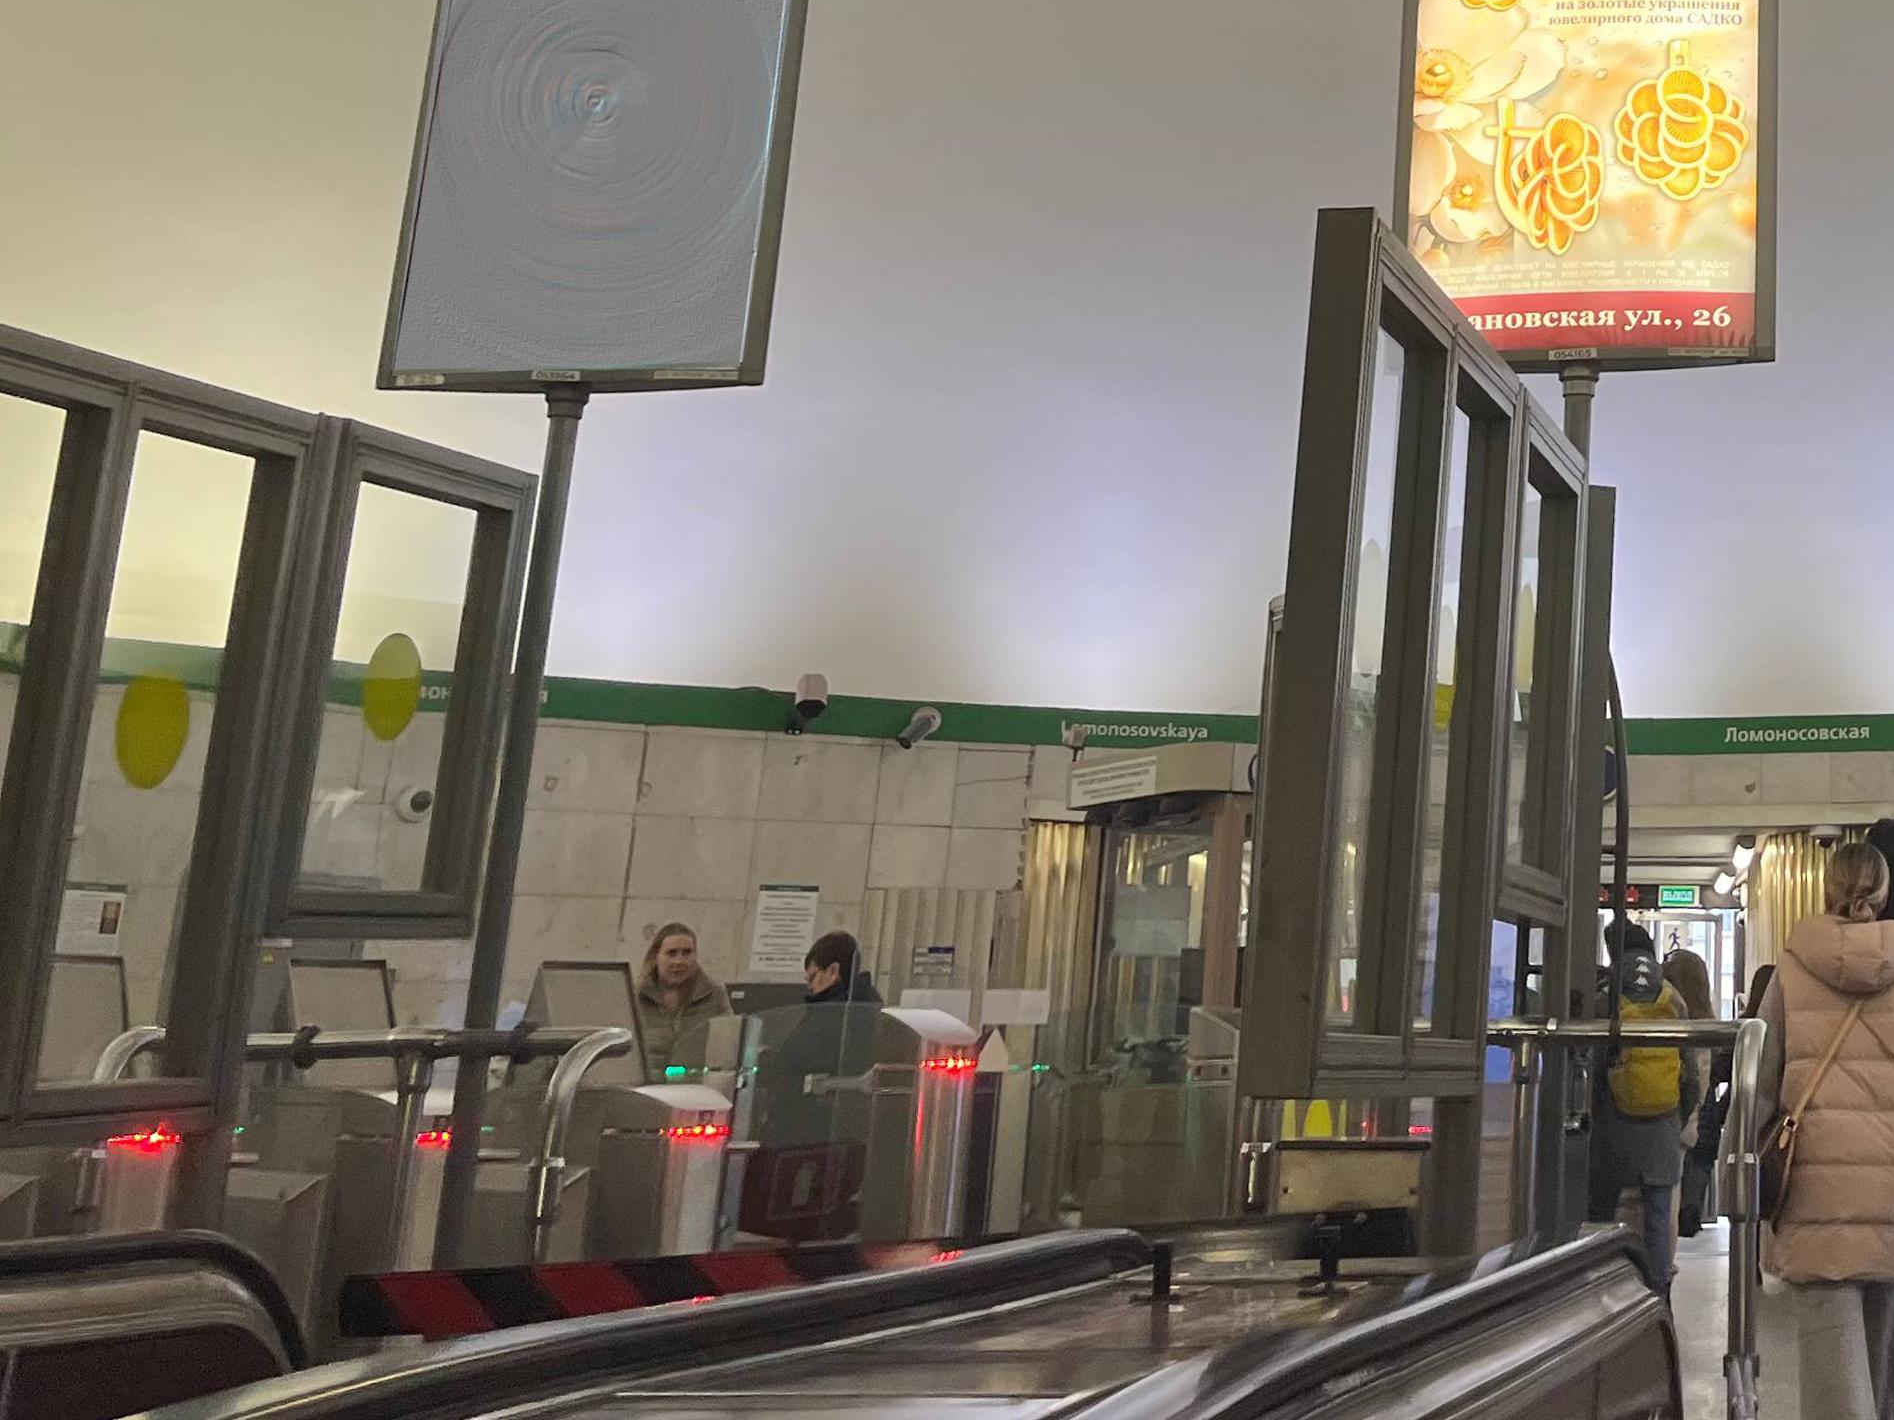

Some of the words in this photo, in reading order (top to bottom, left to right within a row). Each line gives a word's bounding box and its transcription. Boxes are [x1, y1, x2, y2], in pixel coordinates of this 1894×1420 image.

[1555, 0, 1574, 10] на
[1578, 0, 1646, 10] золотые
[1649, 0, 1740, 11] украшения
[1549, 15, 1642, 27] ювелирного
[1645, 14, 1683, 25] дома
[1687, 13, 1743, 26] САДКО
[1623, 310, 1683, 331] ул.,
[1692, 306, 1732, 328] 26
[1724, 726, 1870, 743] Ломоносовская
